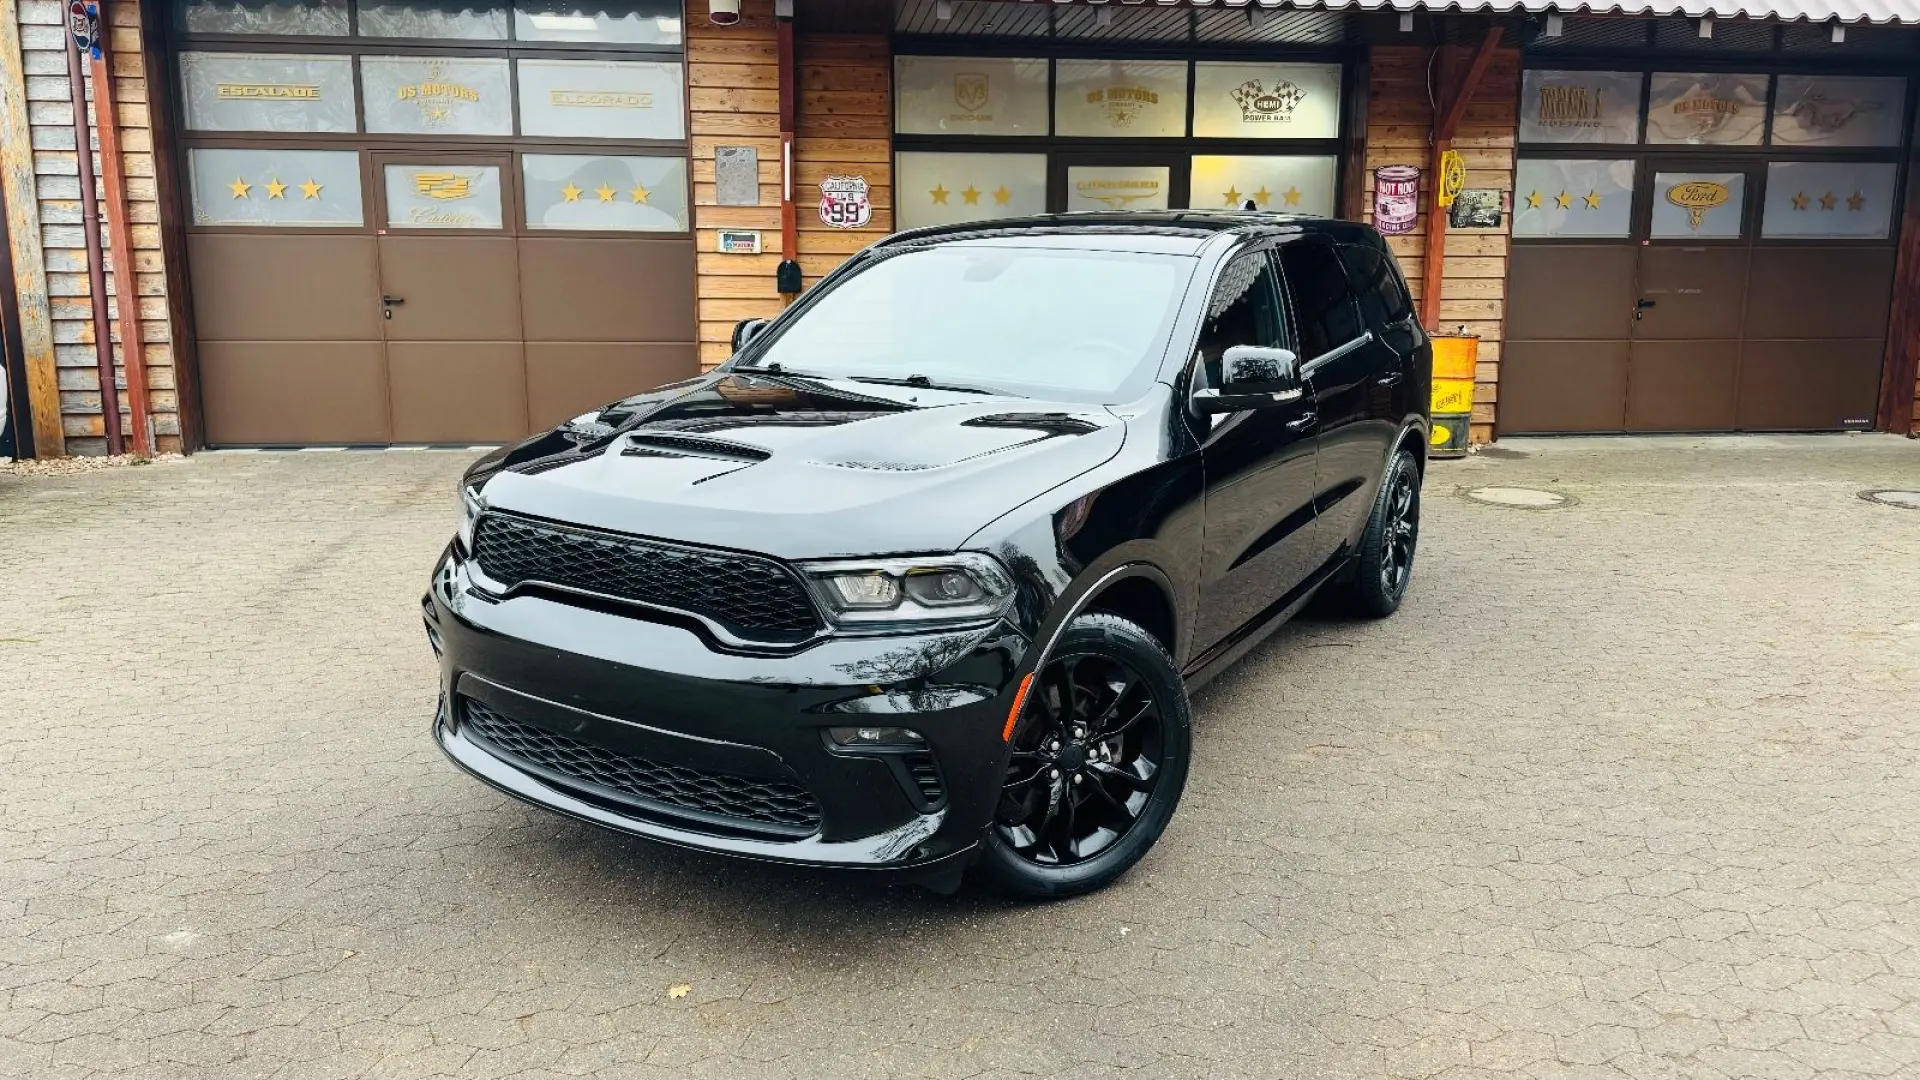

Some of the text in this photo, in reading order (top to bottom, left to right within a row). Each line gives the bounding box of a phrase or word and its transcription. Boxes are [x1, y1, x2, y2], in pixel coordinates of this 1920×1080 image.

[217, 86, 320, 97] ESCALADE
[421, 83, 479, 102] MOTORS
[1107, 87, 1159, 104] MOTORS
[1256, 100, 1280, 109] HEMI
[825, 181, 865, 191] CALIFORNIA
[1380, 181, 1415, 196] HOT ROD
[1680, 185, 1718, 201] Ford
[831, 202, 859, 223] 99
